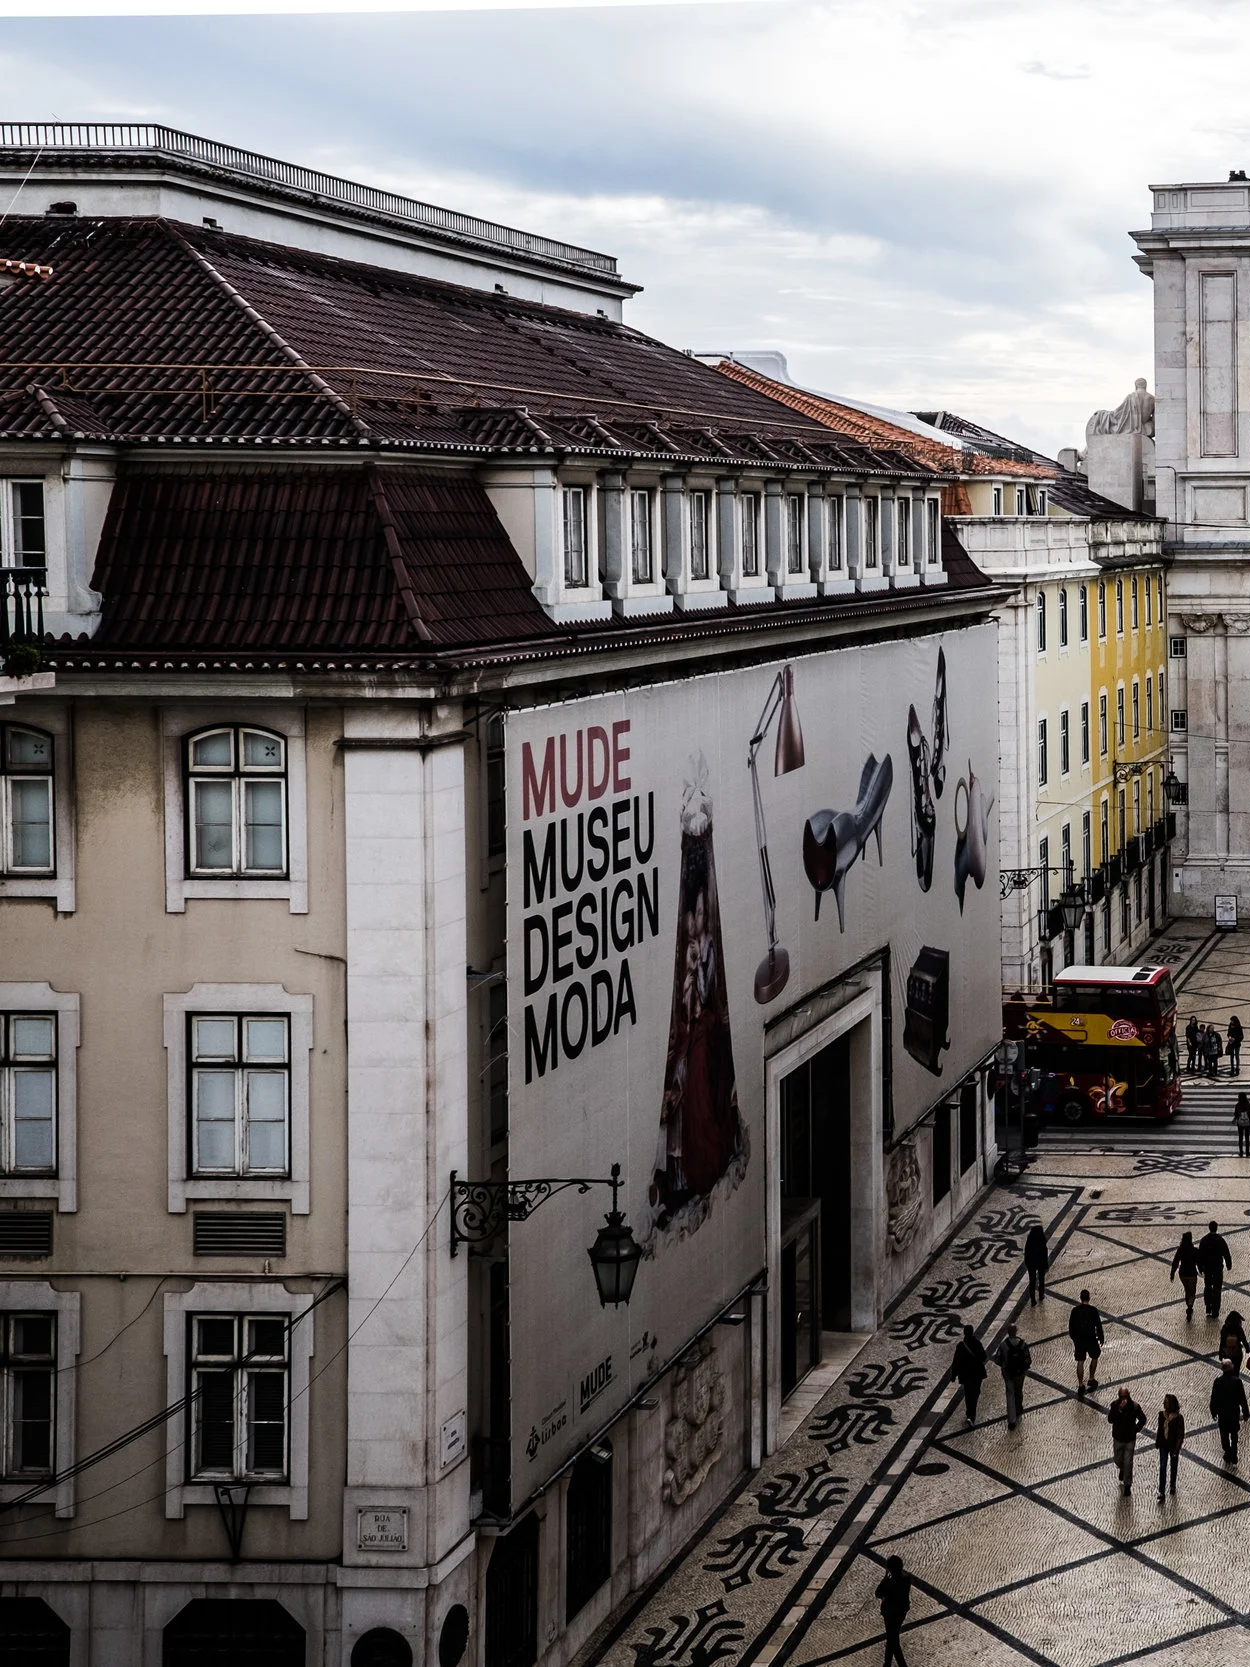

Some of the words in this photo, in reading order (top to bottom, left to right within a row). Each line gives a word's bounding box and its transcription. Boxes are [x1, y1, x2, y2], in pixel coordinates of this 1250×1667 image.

[522, 719, 631, 821] MUDE
[523, 791, 655, 909] MUSEU
[524, 867, 659, 996] DESIGN
[525, 958, 637, 1085] MODA
[580, 1355, 612, 1406] MUDE
[363, 1533, 377, 1542] SÃO
[379, 1533, 402, 1542] JULIÃO
